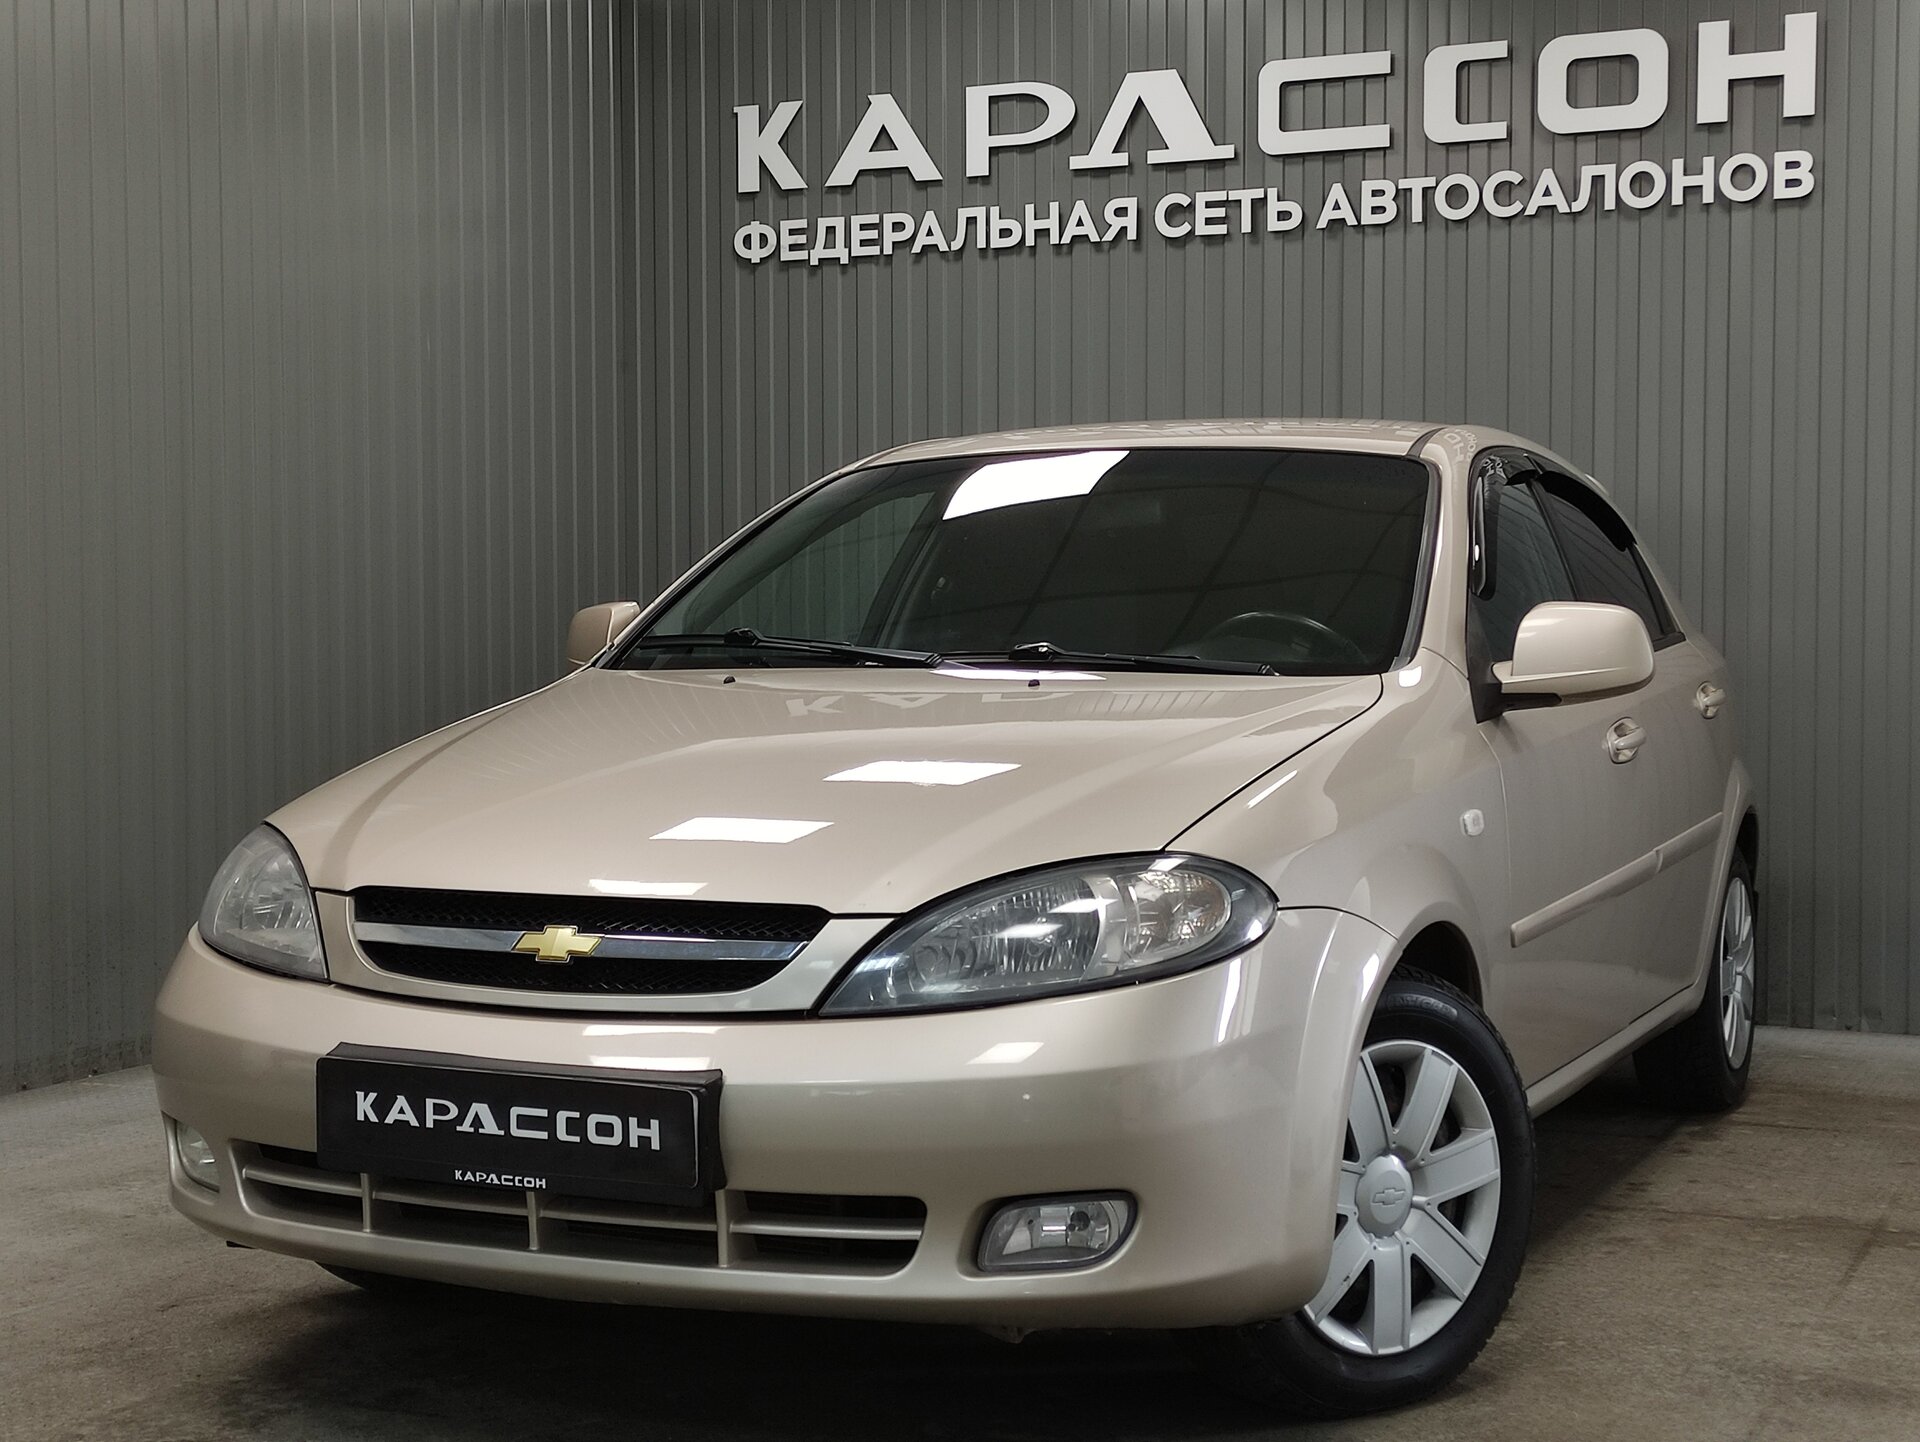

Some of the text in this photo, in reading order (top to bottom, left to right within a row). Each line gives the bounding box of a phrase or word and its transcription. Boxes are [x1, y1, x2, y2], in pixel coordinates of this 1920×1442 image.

[733, 150, 1816, 266] ФЕДЕРАЛЬНАЯ СЕТЬ АВТОСАЛОНОВ
